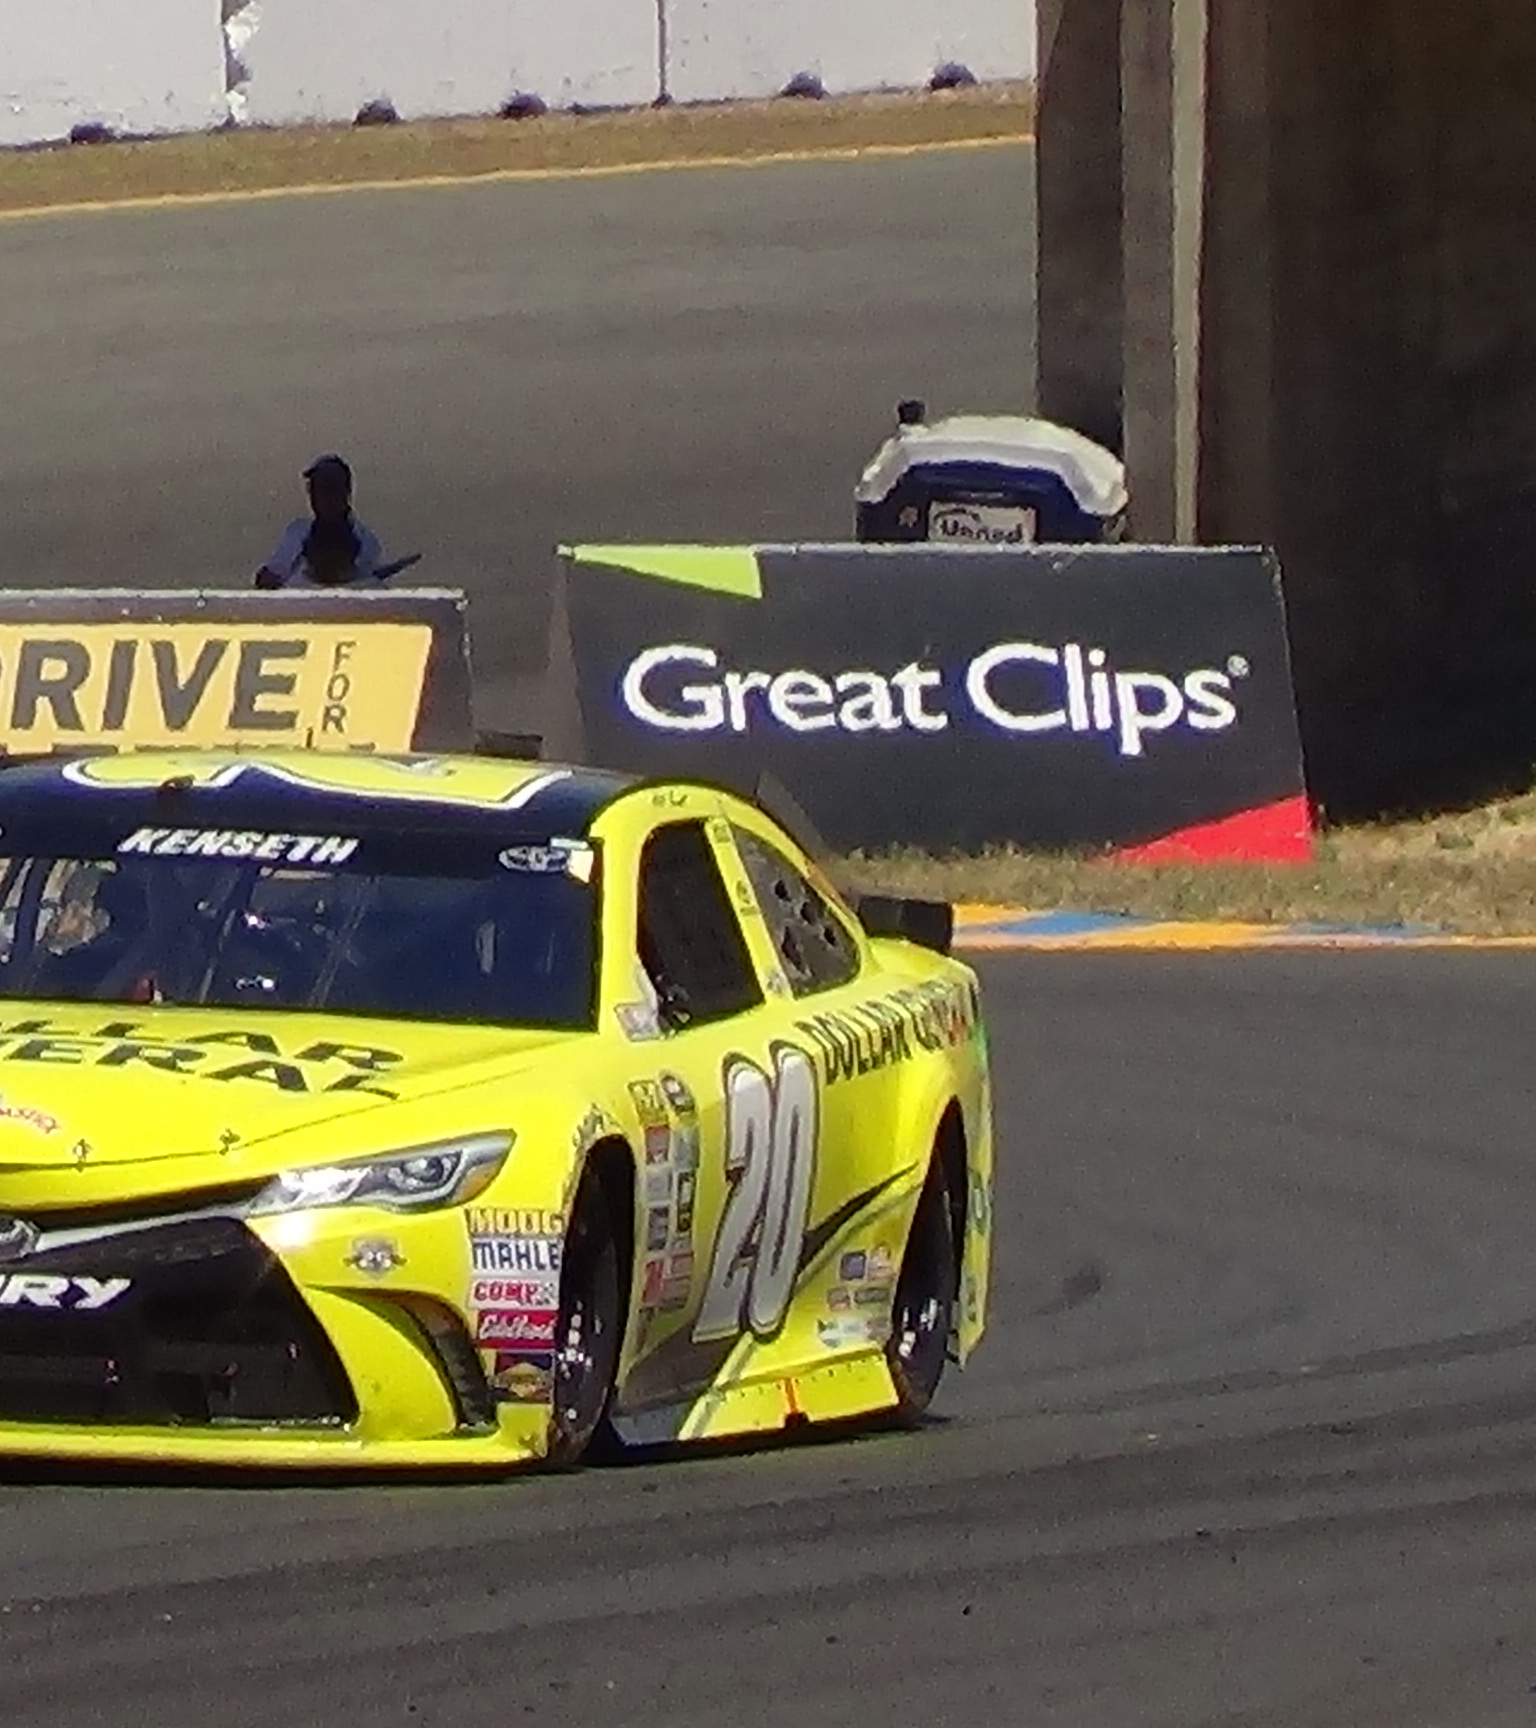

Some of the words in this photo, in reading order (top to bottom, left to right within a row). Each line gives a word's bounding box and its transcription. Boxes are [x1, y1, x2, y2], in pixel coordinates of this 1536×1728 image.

[321, 640, 357, 734] FOR
[622, 643, 948, 732] Great
[117, 826, 361, 864] KENSETH
[467, 1207, 563, 1236] MOOG
[691, 1039, 821, 1344] 20
[472, 1239, 561, 1271] MAHLE
